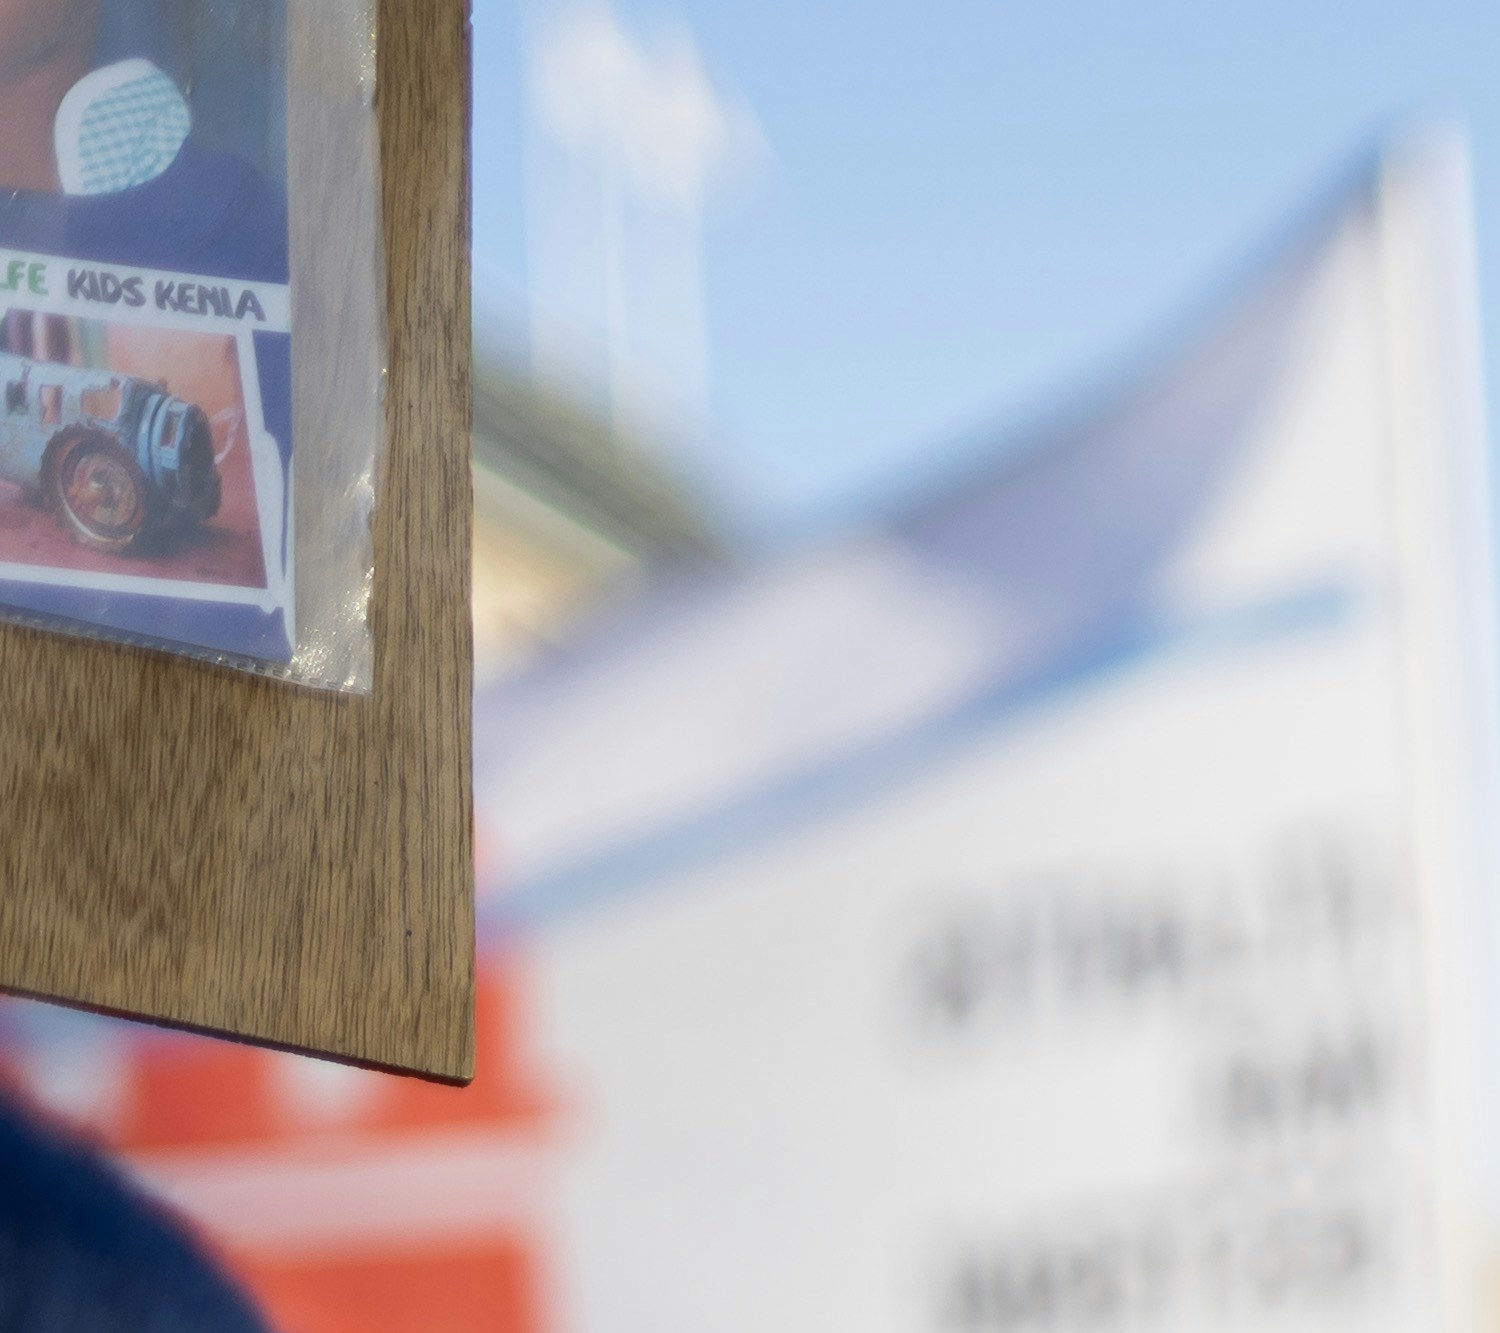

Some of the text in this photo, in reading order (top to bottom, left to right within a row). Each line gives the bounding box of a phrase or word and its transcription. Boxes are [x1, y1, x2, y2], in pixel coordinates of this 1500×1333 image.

[0, 260, 267, 322] FE KIDS KENIA
